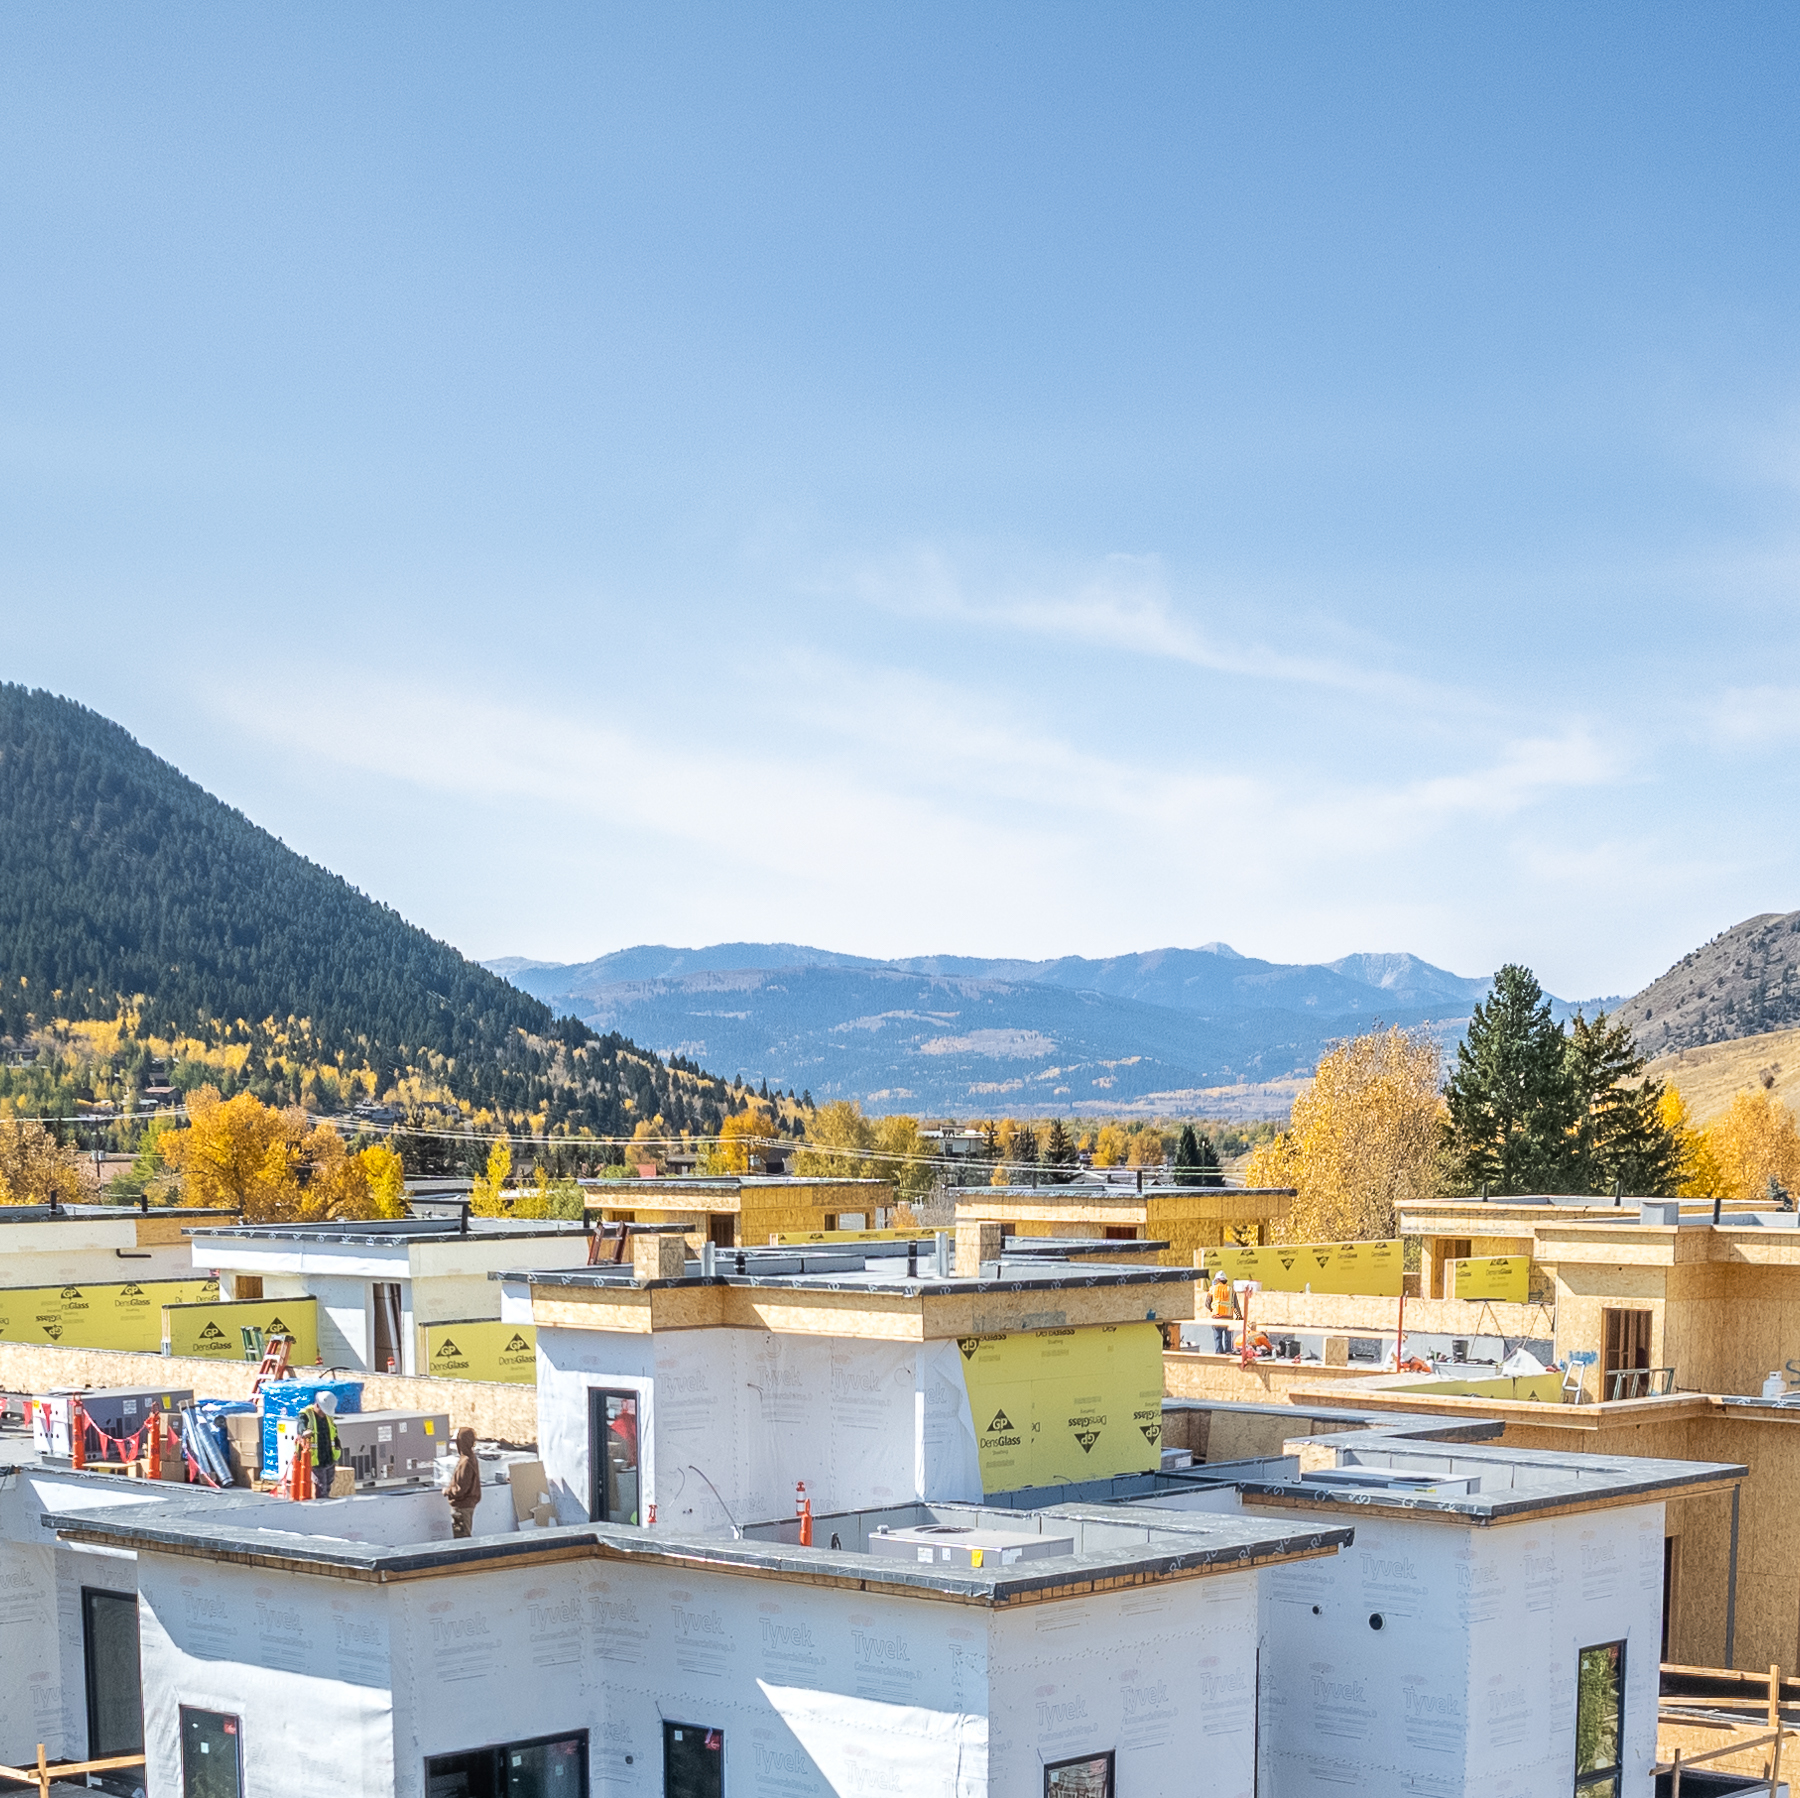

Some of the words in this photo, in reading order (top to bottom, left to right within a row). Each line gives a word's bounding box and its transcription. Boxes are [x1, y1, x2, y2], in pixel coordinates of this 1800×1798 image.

[114, 1298, 151, 1308] DensGlass
[125, 1284, 140, 1295] GP
[203, 1328, 220, 1339] GP
[268, 1323, 285, 1334] GP
[193, 1340, 233, 1352] DensGlass
[441, 1346, 456, 1356] GP
[510, 1340, 524, 1350] GP
[430, 1361, 469, 1372] DensGlass
[499, 1355, 536, 1366] DensGlass
[657, 1370, 708, 1400] Tyvek
[757, 1366, 802, 1393] Tyvek
[833, 1368, 881, 1394] Tyvek
[992, 1418, 1008, 1430] GP
[980, 1436, 1021, 1449] DensGlass
[1360, 1553, 1416, 1580] Tyvek
[255, 1602, 301, 1631] Tyvek
[527, 1599, 582, 1631] Tyvek
[588, 1596, 640, 1625] Tyvek
[671, 1606, 725, 1635] Tyvek
[333, 1615, 382, 1646] Tyvek
[429, 1611, 490, 1645] Tyvek
[759, 1617, 813, 1648] Tyvek
[851, 1630, 908, 1662] Tyvek
[1121, 1680, 1168, 1715] Tyvek
[1311, 1676, 1365, 1702] Tyvek
[1403, 1688, 1460, 1715] Tyvek
[1036, 1695, 1087, 1731] Tyvek
[753, 1743, 806, 1774] Tyvek
[845, 1757, 902, 1793] Tyvek
